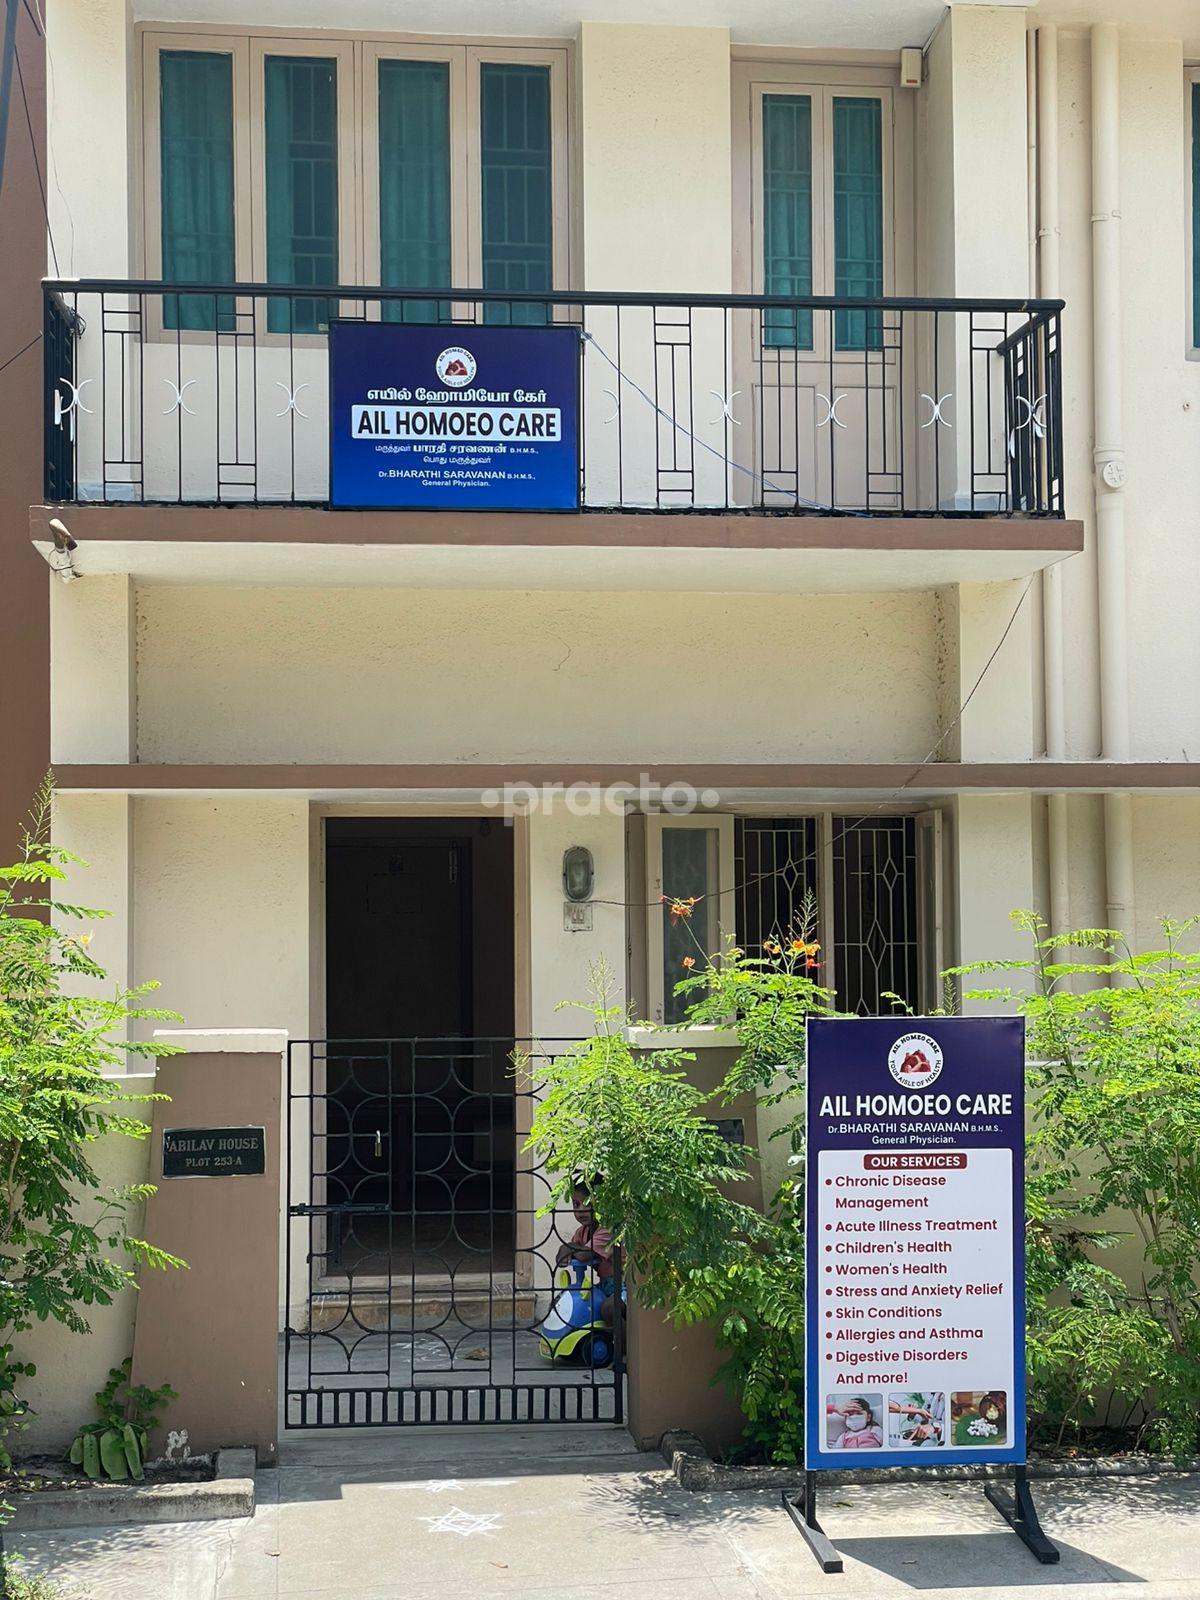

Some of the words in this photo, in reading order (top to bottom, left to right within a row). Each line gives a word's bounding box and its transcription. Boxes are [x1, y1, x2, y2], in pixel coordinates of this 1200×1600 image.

[367, 387, 412, 401] எயில்
[415, 388, 510, 404] ஹோமியோ
[513, 389, 547, 403] கேர்
[358, 410, 391, 435] AIL
[396, 411, 494, 437] HOMOEO
[498, 413, 556, 437] CARE
[413, 442, 447, 454] பாரதி
[449, 443, 507, 454] சரவணன்
[443, 470, 506, 479] SARAVANAN
[452, 480, 491, 488] Physician.
[892, 1043, 901, 1054] AIL
[900, 1034, 926, 1044] HOMEO
[925, 1038, 940, 1055] CARE
[890, 1059, 900, 1077] YOUR
[897, 1076, 915, 1087] AISLE
[924, 1059, 942, 1084] HEALTH
[819, 1095, 851, 1117] AIL
[856, 1094, 951, 1116] HOMOEO
[956, 1094, 1012, 1115] CARE
[899, 1122, 969, 1133] SARAVANAN
[168, 1139, 216, 1152] ABILAV
[218, 1137, 259, 1150] HOUSE
[872, 1136, 907, 1145] General
[909, 1135, 957, 1146] Physician.
[185, 1157, 211, 1168] PLOT
[871, 1157, 898, 1168] OUR
[900, 1156, 961, 1167] SERVICES
[835, 1175, 890, 1187] Chronic
[893, 1174, 947, 1187] Disease
[835, 1197, 929, 1212] Management
[835, 1219, 876, 1232] Acute
[878, 1219, 922, 1231] Illness
[925, 1218, 998, 1231] Treatment
[835, 1241, 904, 1254] Children's
[907, 1241, 952, 1253] Health
[835, 1262, 900, 1275] Women's
[902, 1262, 948, 1275] Health
[835, 1285, 878, 1297] Stress
[880, 1283, 908, 1296] and
[911, 1283, 963, 1298] Anxiety
[965, 1282, 1004, 1295] Relief
[835, 1306, 865, 1319] Skin
[867, 1305, 943, 1318] Conditions
[835, 1328, 896, 1344] Allergies
[898, 1328, 926, 1340] and
[929, 1327, 984, 1339] Asthma
[835, 1350, 900, 1366] Digestive
[902, 1348, 969, 1362] Disorders
[836, 1371, 864, 1385] And
[867, 1371, 909, 1384] more!
